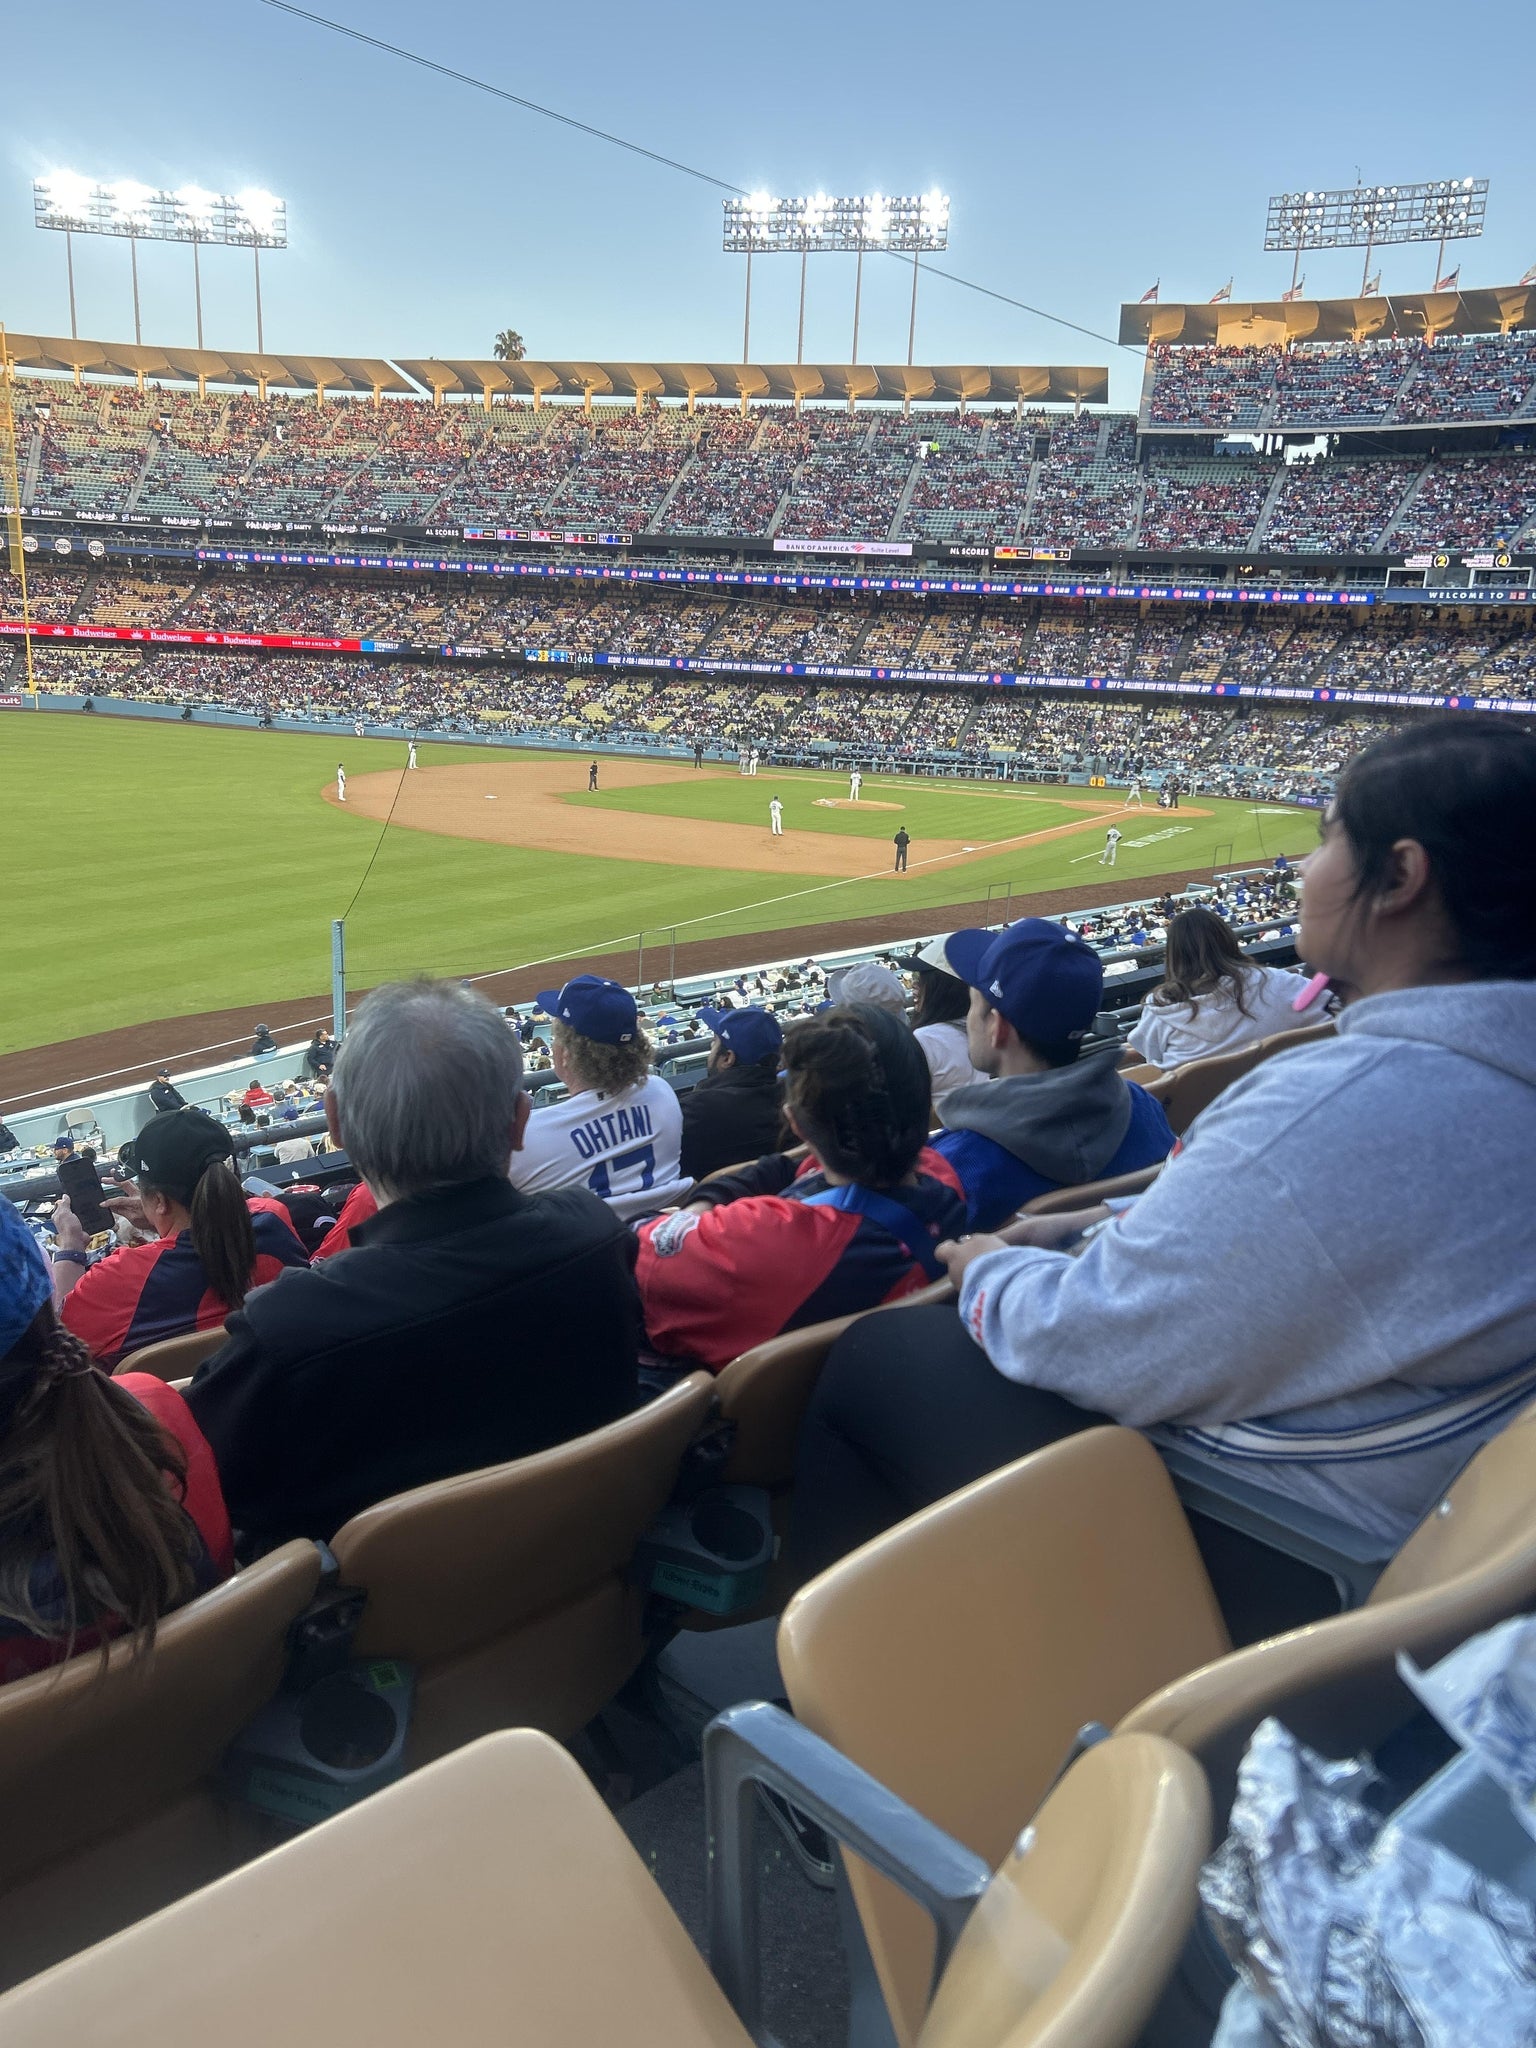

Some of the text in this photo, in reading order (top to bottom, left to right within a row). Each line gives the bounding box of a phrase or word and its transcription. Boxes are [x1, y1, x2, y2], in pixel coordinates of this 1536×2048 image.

[1438, 556, 1447, 566] 2
[1499, 555, 1508, 566] 4
[0, 626, 38, 634] udweier
[73, 628, 117, 637] Budweiser
[150, 632, 192, 641] Budweiser
[223, 636, 262, 645] Budweiser
[570, 1105, 653, 1159] OHTANI
[588, 1144, 656, 1198] 17
